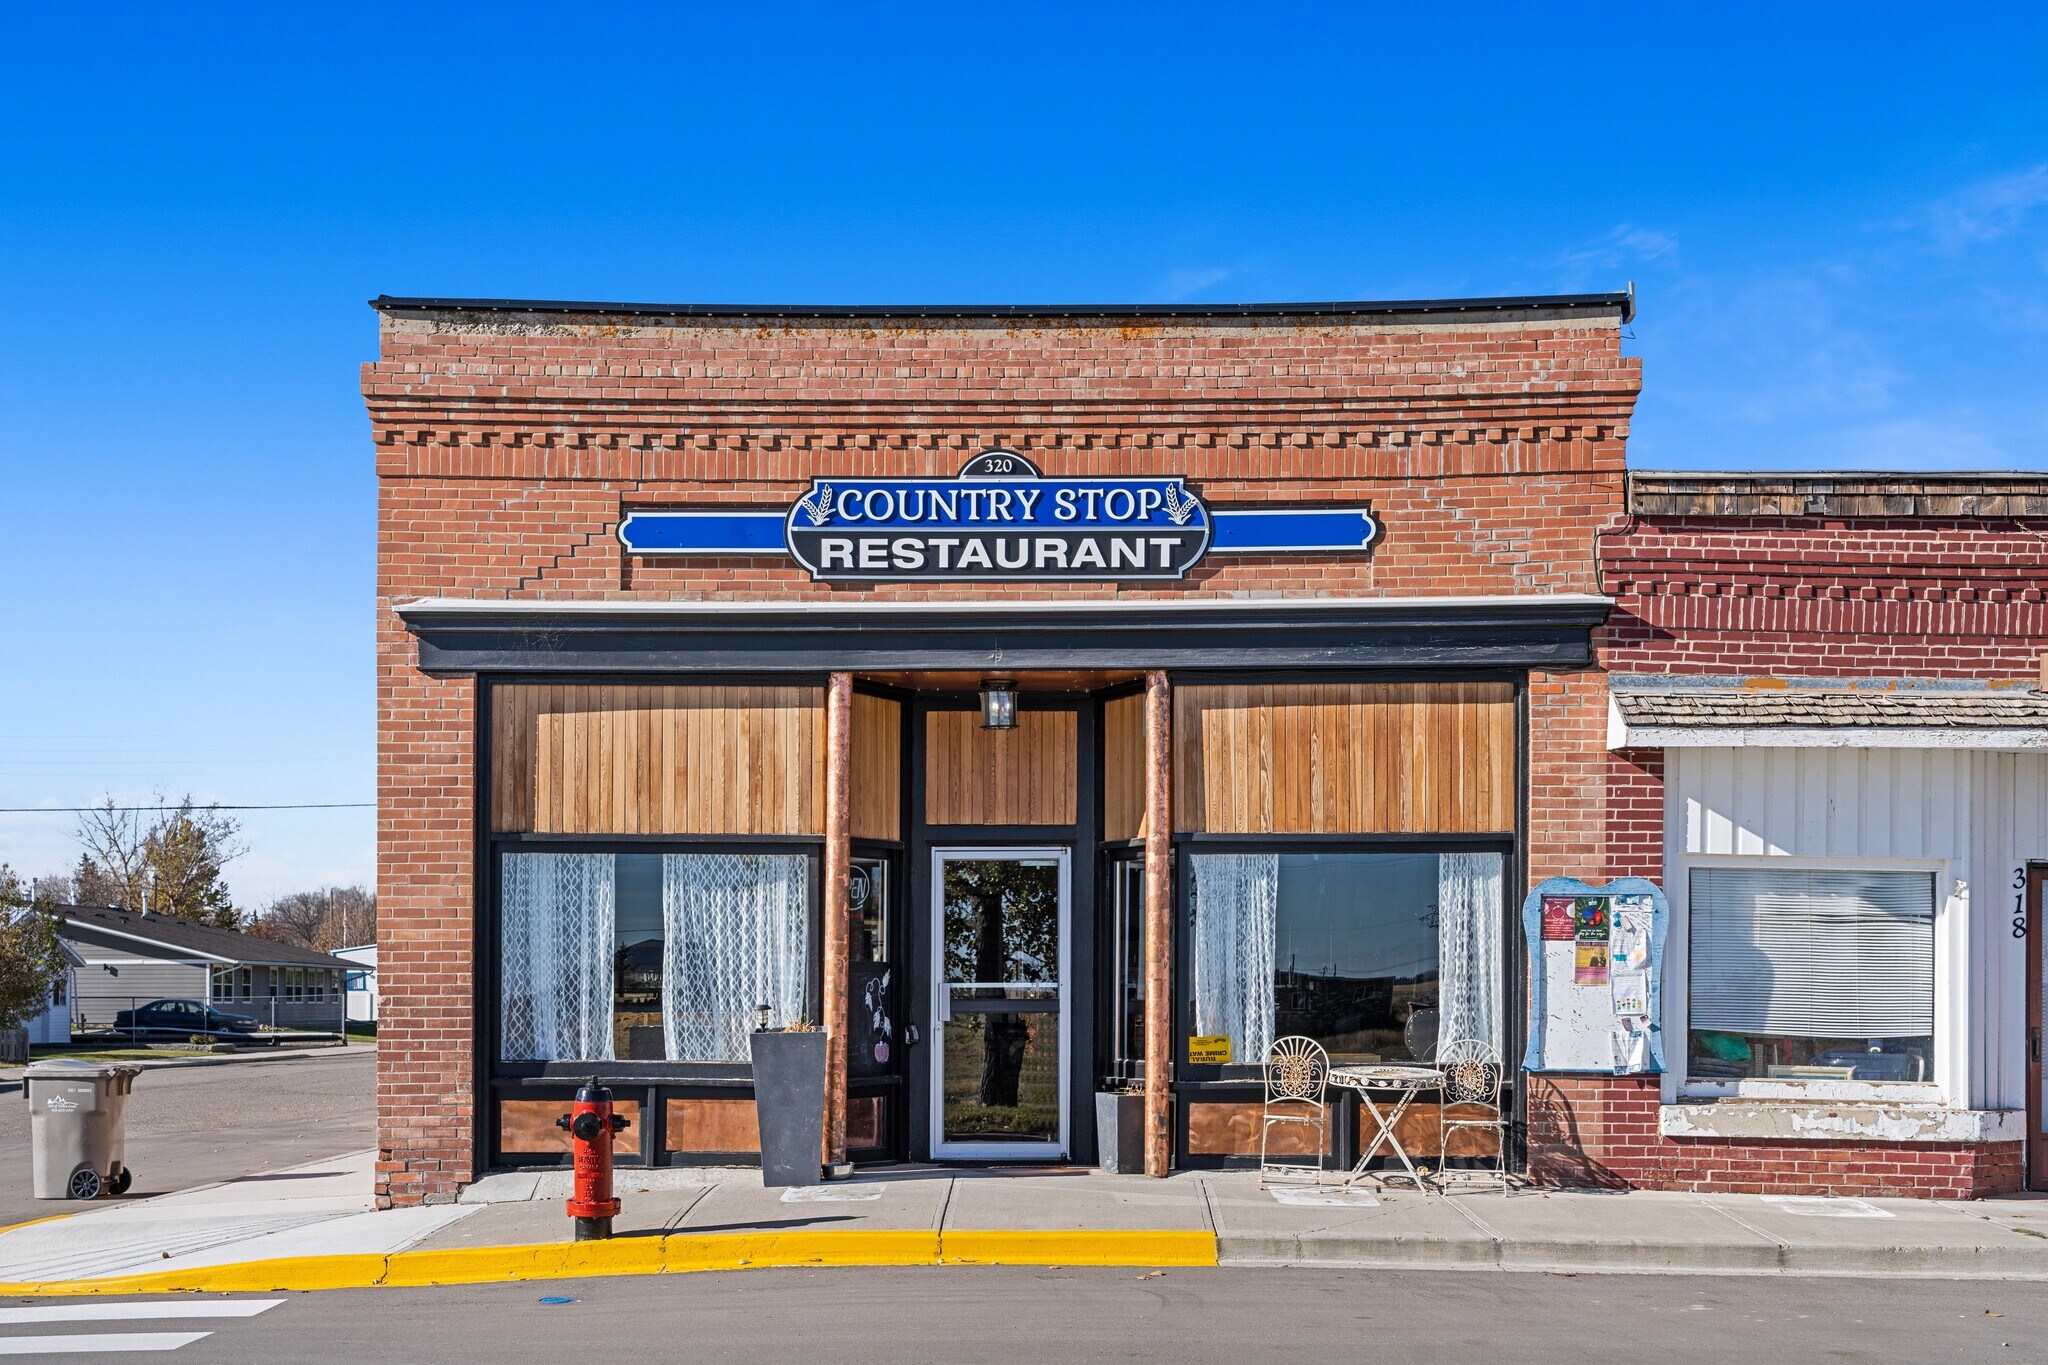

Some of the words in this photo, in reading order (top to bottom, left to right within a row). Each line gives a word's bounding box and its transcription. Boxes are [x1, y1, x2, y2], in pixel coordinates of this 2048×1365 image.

[984, 459, 1013, 473] 320
[837, 488, 1041, 521] COUNTRY
[1054, 488, 1162, 521] STOP
[820, 537, 1182, 569] RESTAURANT
[2012, 867, 2027, 939] 318
